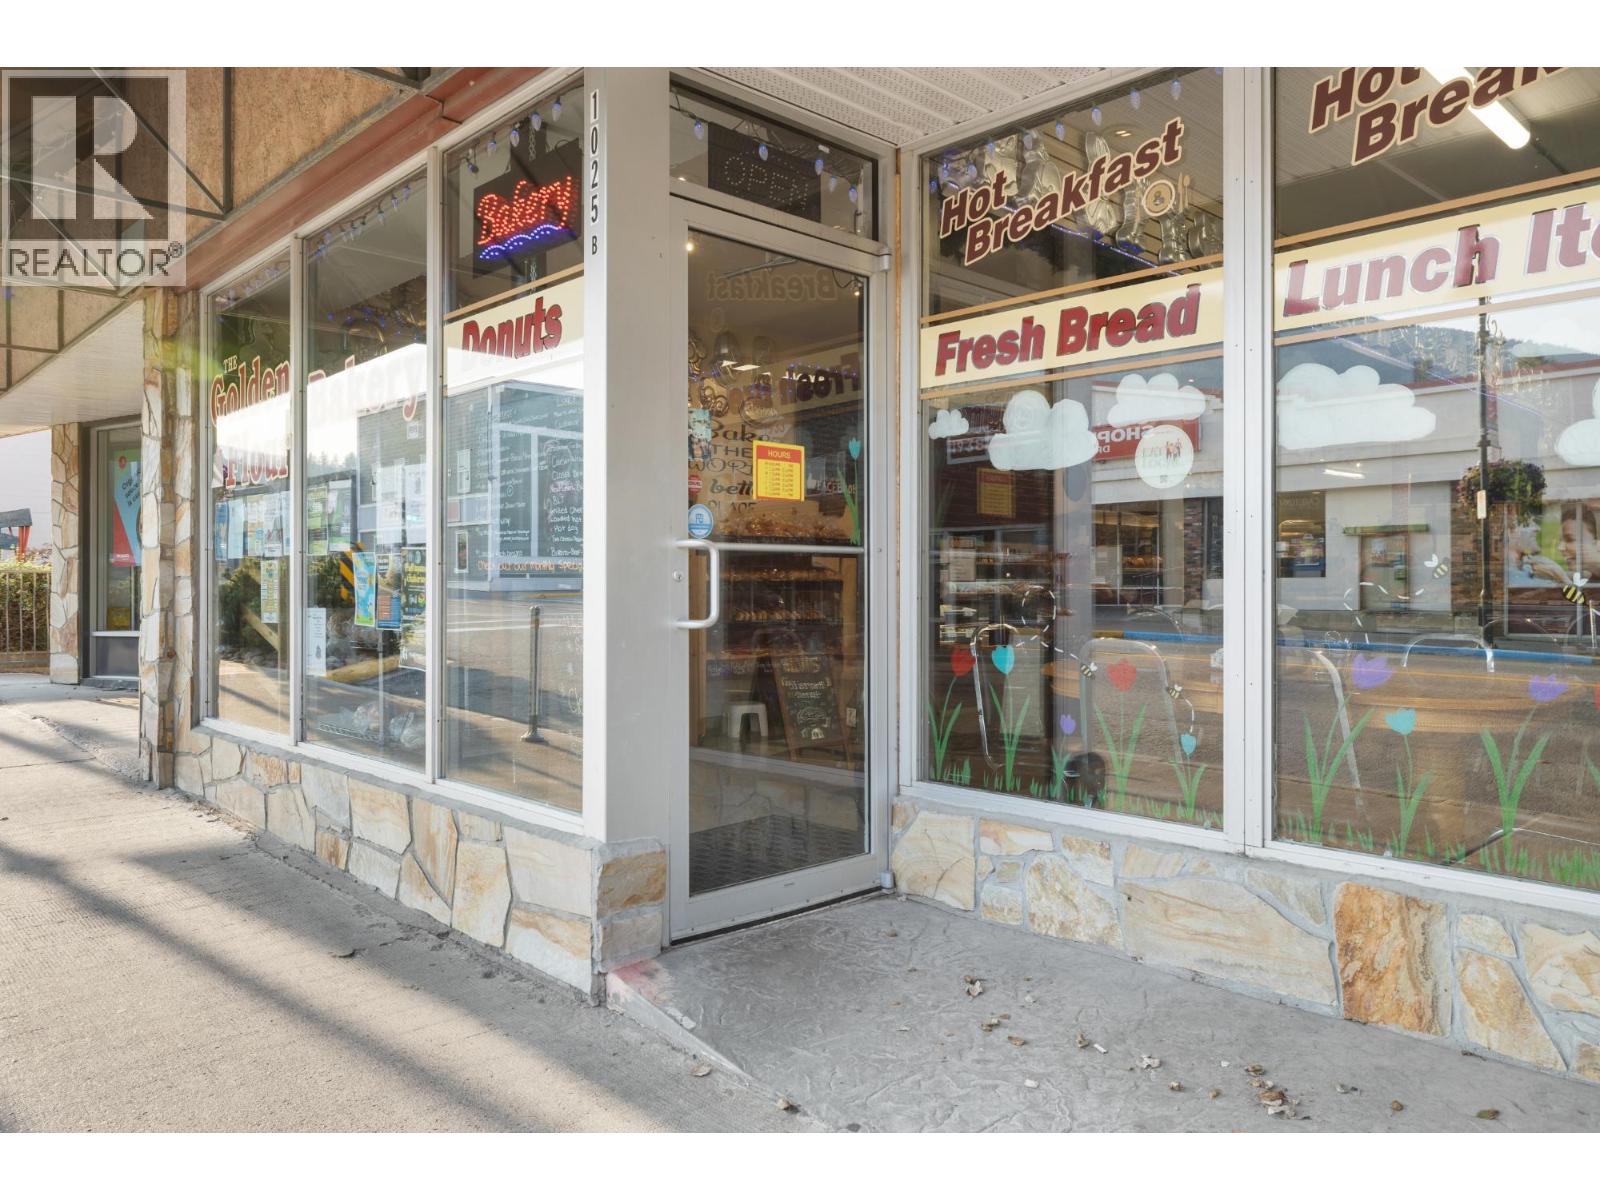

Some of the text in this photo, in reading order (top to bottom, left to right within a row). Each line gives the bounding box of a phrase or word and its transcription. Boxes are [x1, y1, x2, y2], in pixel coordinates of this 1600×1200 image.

[477, 176, 572, 245] Bakery
[940, 170, 1008, 239] Hot
[965, 116, 1184, 266] Breakfast
[1283, 224, 1500, 317] Lunch
[462, 296, 563, 359] Donuts
[935, 283, 1201, 376] Fresh Bread
[210, 355, 290, 428] Golden
[223, 355, 238, 374] THE
[768, 449, 791, 460] HOURS
